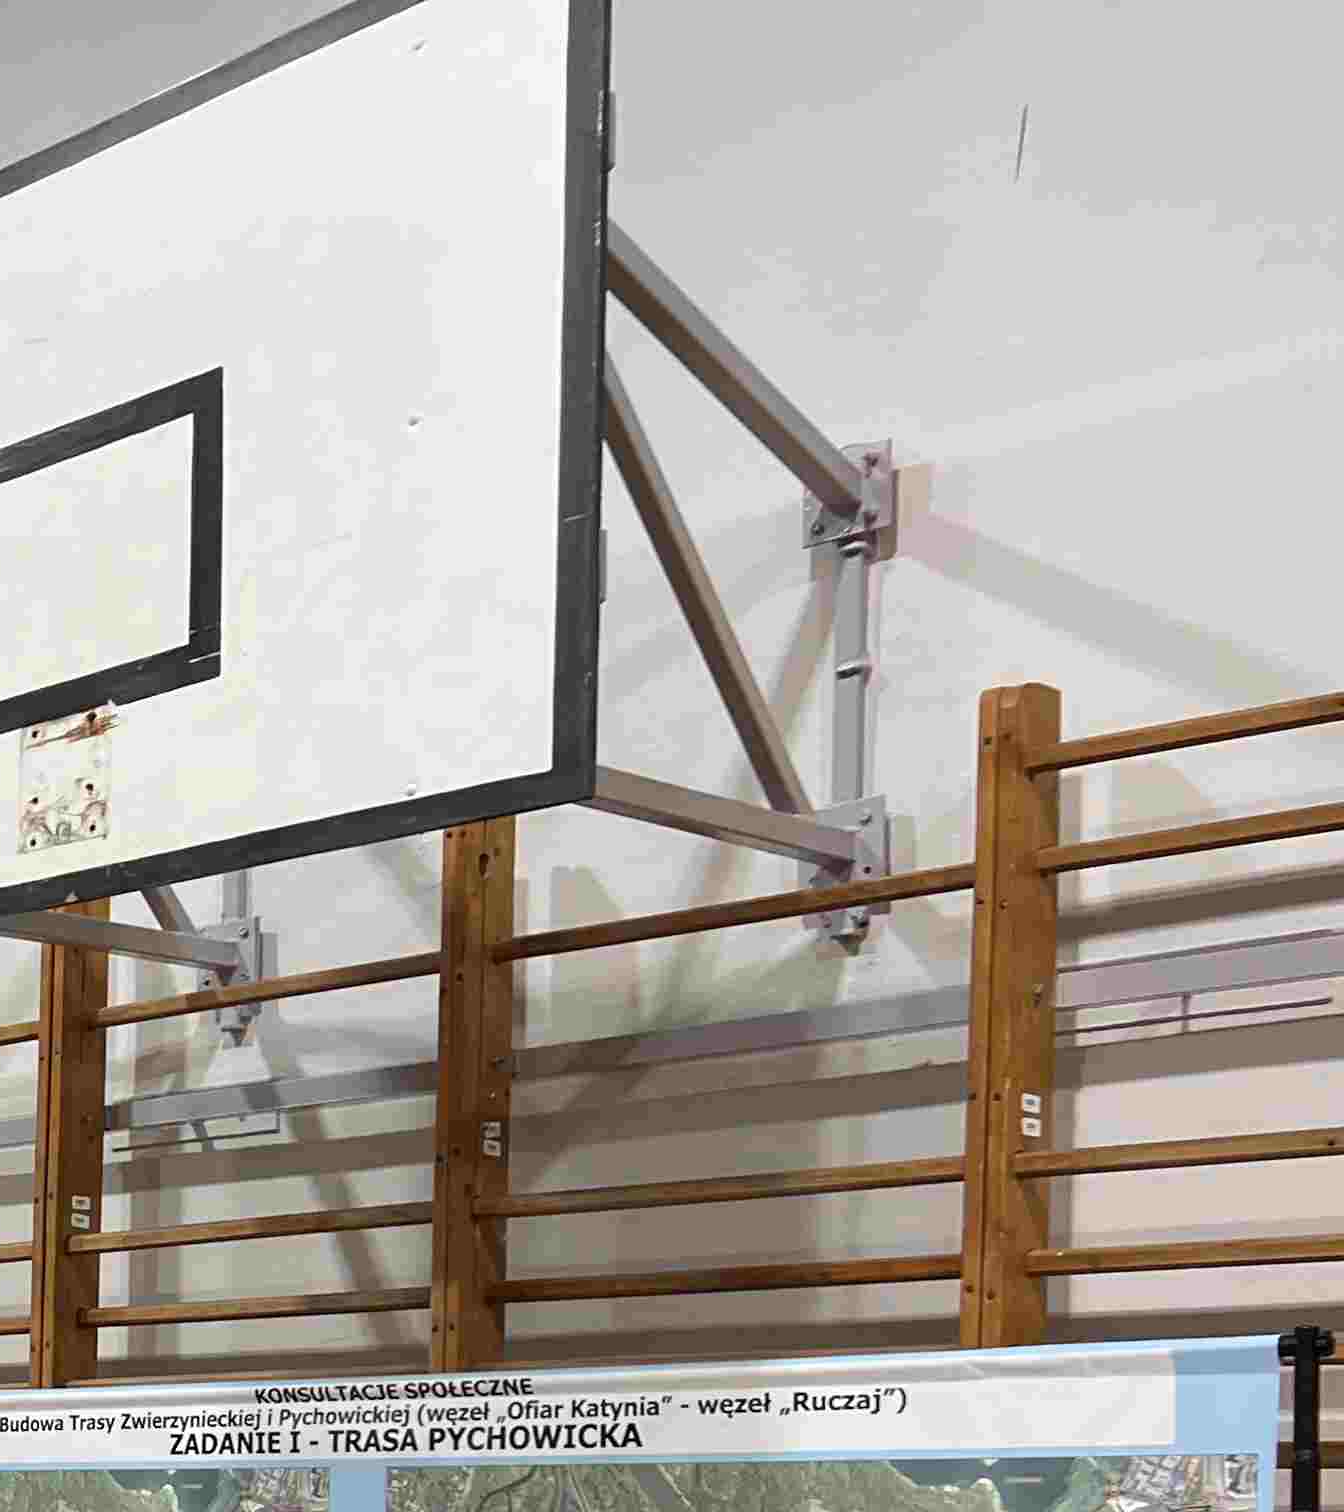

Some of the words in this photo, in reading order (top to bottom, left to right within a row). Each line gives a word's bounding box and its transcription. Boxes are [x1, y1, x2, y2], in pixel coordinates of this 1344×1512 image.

[255, 1383, 398, 1405] KONSULTACJE
[405, 1378, 534, 1400] SPOŁECZNE
[0, 1416, 64, 1433] Budowa
[69, 1414, 116, 1433] Trasy
[120, 1410, 261, 1433] Zwierzynieckiej
[267, 1410, 273, 1427] i
[279, 1404, 411, 1430] Pychowickiej
[417, 1401, 490, 1426] (węzeł
[496, 1399, 563, 1423] „Ofiar
[698, 1392, 771, 1418] węzeł
[170, 1432, 281, 1456] ZADANIE
[289, 1431, 301, 1454] I
[328, 1428, 418, 1454] TRASA
[429, 1422, 643, 1452] PYCHOWICKA
